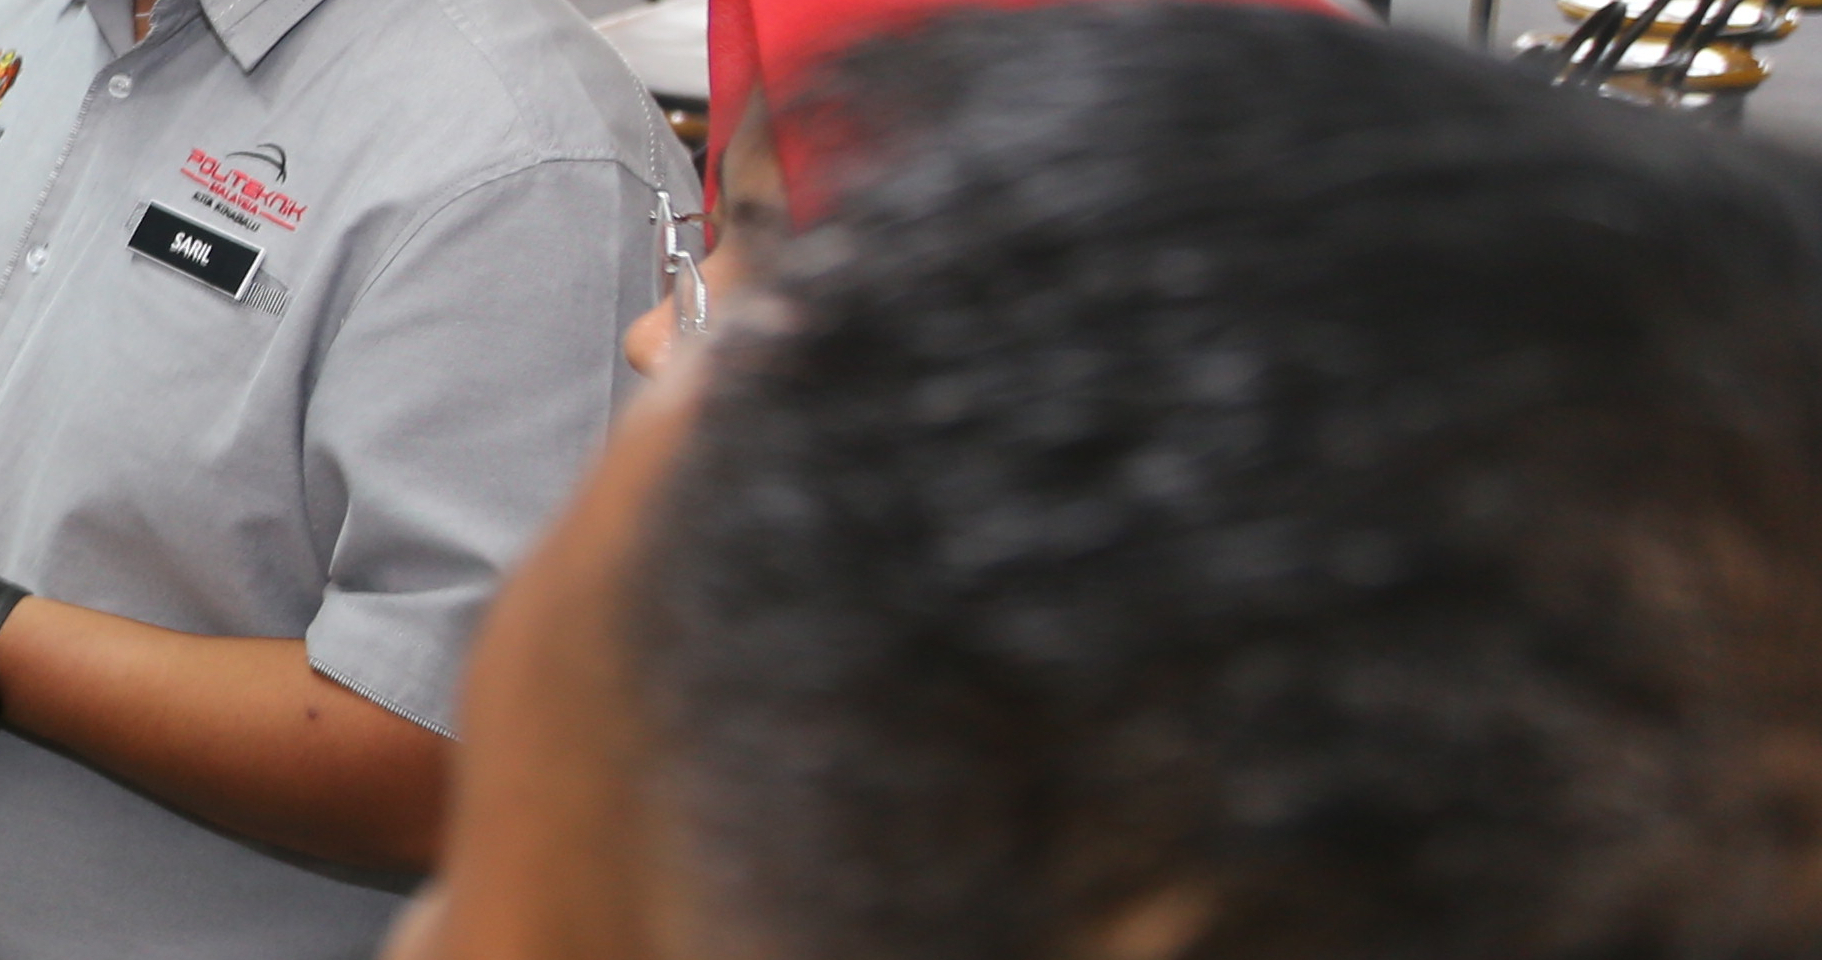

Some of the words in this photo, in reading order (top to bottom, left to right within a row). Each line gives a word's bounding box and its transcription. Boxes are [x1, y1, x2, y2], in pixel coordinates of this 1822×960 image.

[187, 148, 308, 221] POLITEKNIK
[209, 182, 261, 215] MALAYSIA
[170, 231, 213, 266] SARIL
